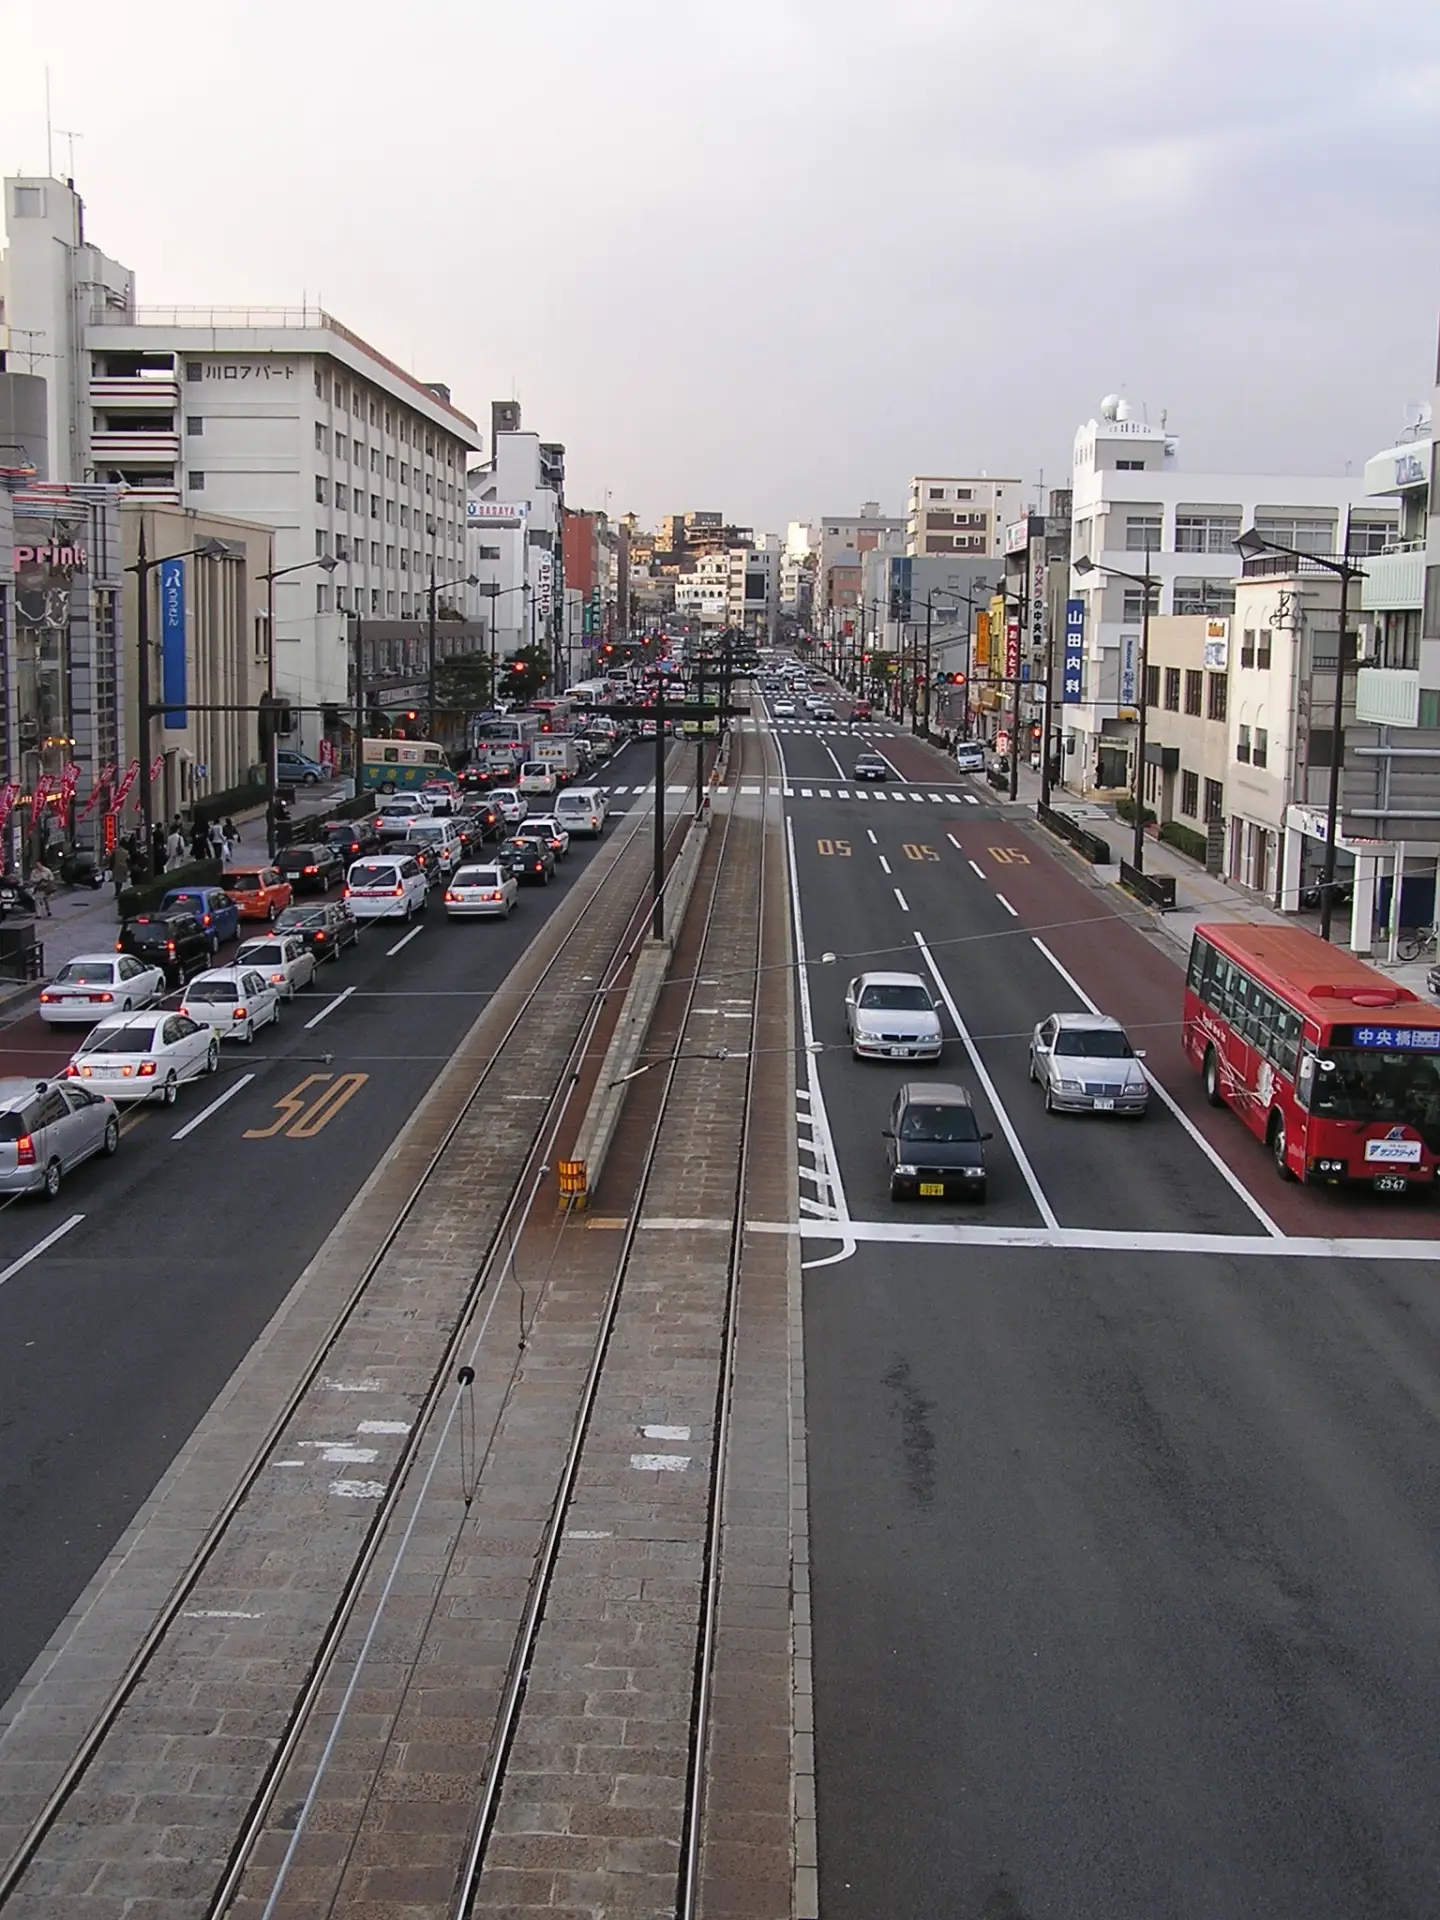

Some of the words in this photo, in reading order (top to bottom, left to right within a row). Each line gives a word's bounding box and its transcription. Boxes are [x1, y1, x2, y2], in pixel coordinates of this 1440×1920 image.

[206, 364, 294, 380] 川口アパート
[479, 506, 515, 516] SASAYA
[1065, 610, 1083, 694] 山田内科
[1358, 1028, 1411, 1047] 中央橋
[241, 1073, 370, 1139] 50
[1380, 1179, 1405, 1190] 29-67
